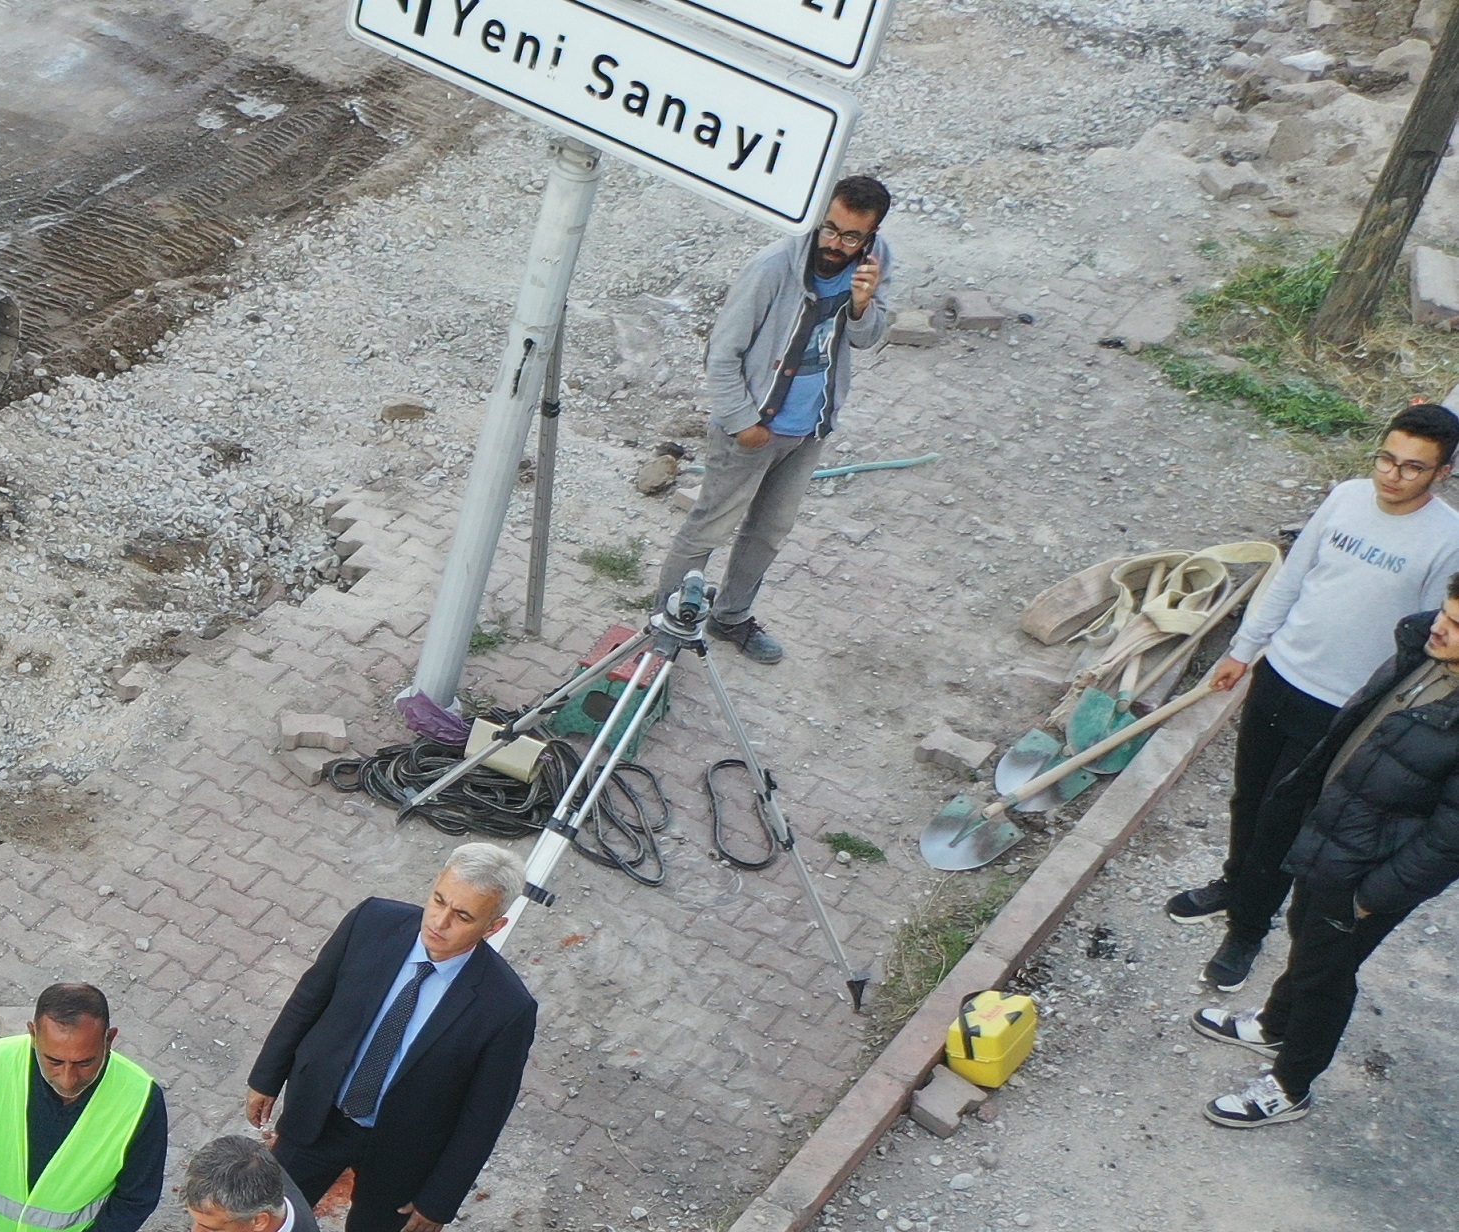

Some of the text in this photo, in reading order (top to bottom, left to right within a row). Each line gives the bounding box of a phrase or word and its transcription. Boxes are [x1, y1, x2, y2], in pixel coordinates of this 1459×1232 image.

[452, 0, 786, 175] Yeni Sanayi
[1359, 546, 1407, 574] JEANS
